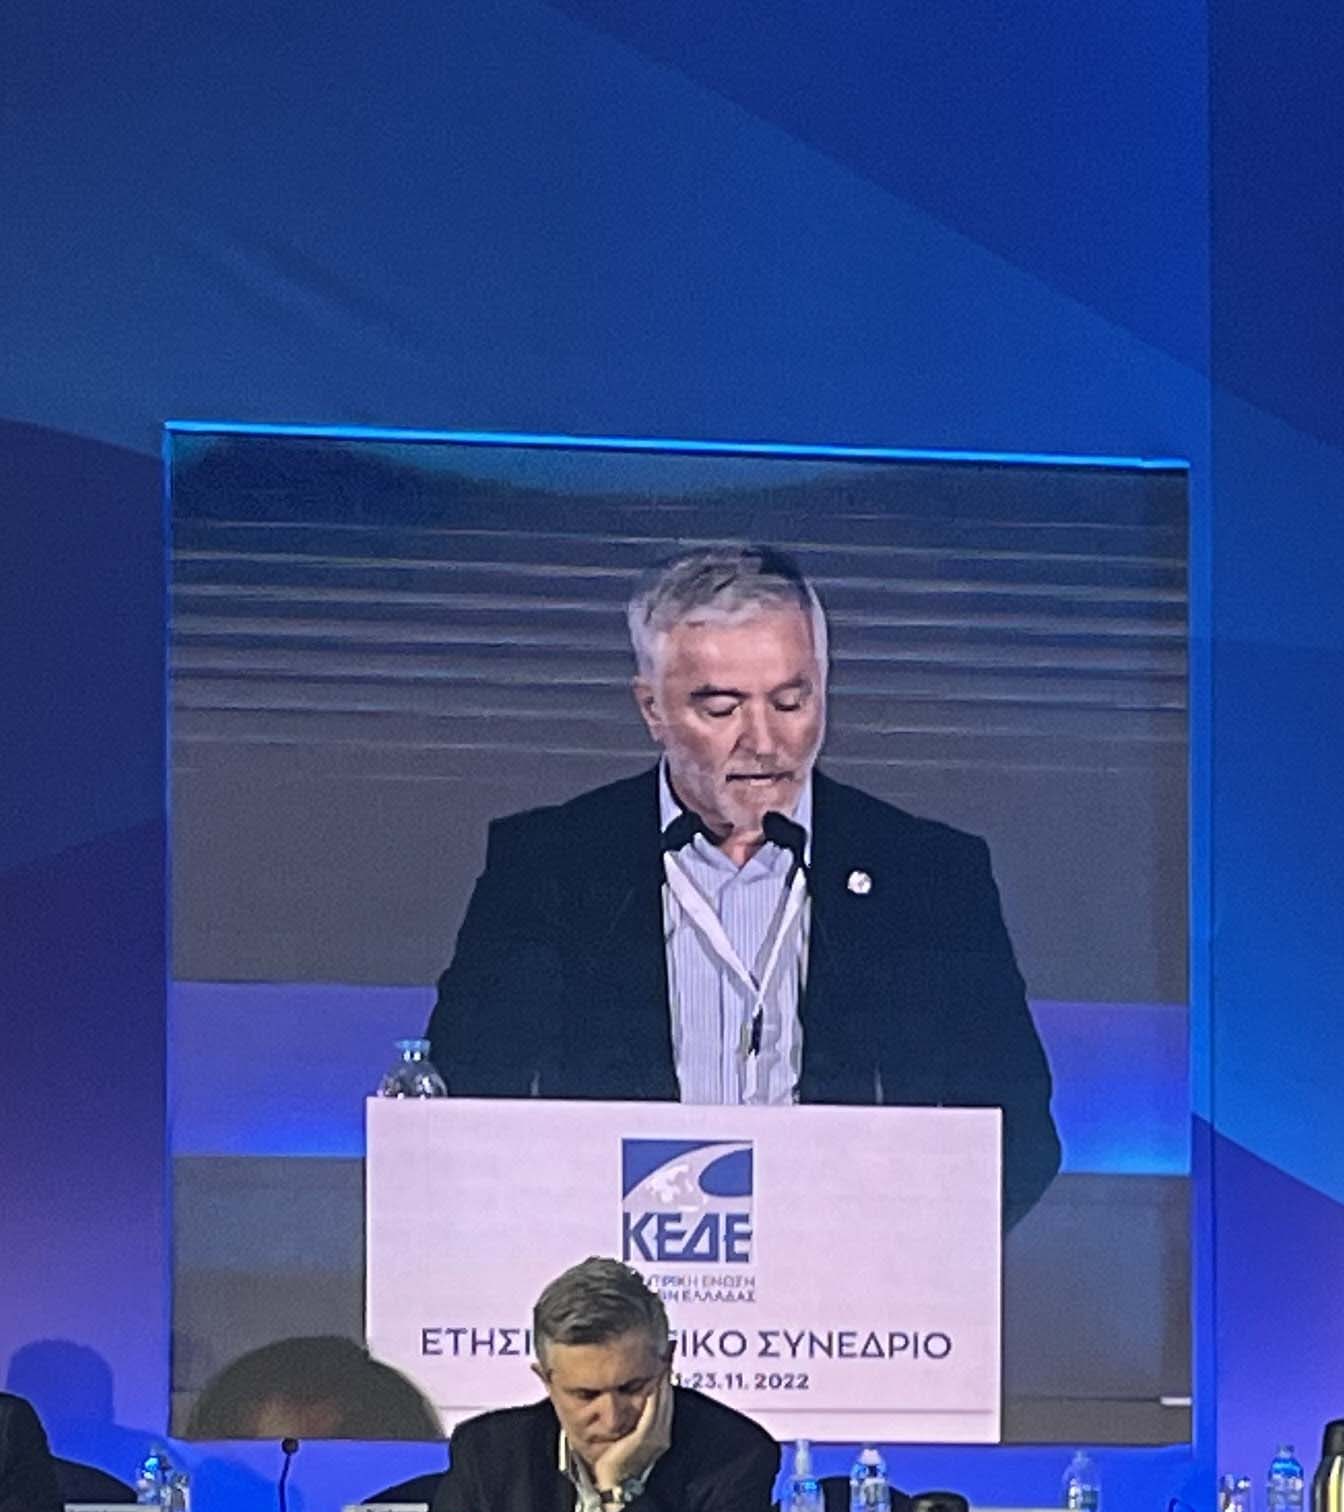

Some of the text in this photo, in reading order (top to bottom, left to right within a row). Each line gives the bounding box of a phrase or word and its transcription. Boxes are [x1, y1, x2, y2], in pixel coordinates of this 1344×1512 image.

[623, 1212, 752, 1263] ΚΕΔΕ
[422, 1327, 531, 1356] ΕΤΗΣΙ
[758, 1329, 953, 1359] ΣΥΝΕΔΡΙΟ
[754, 1373, 809, 1390] 2022
